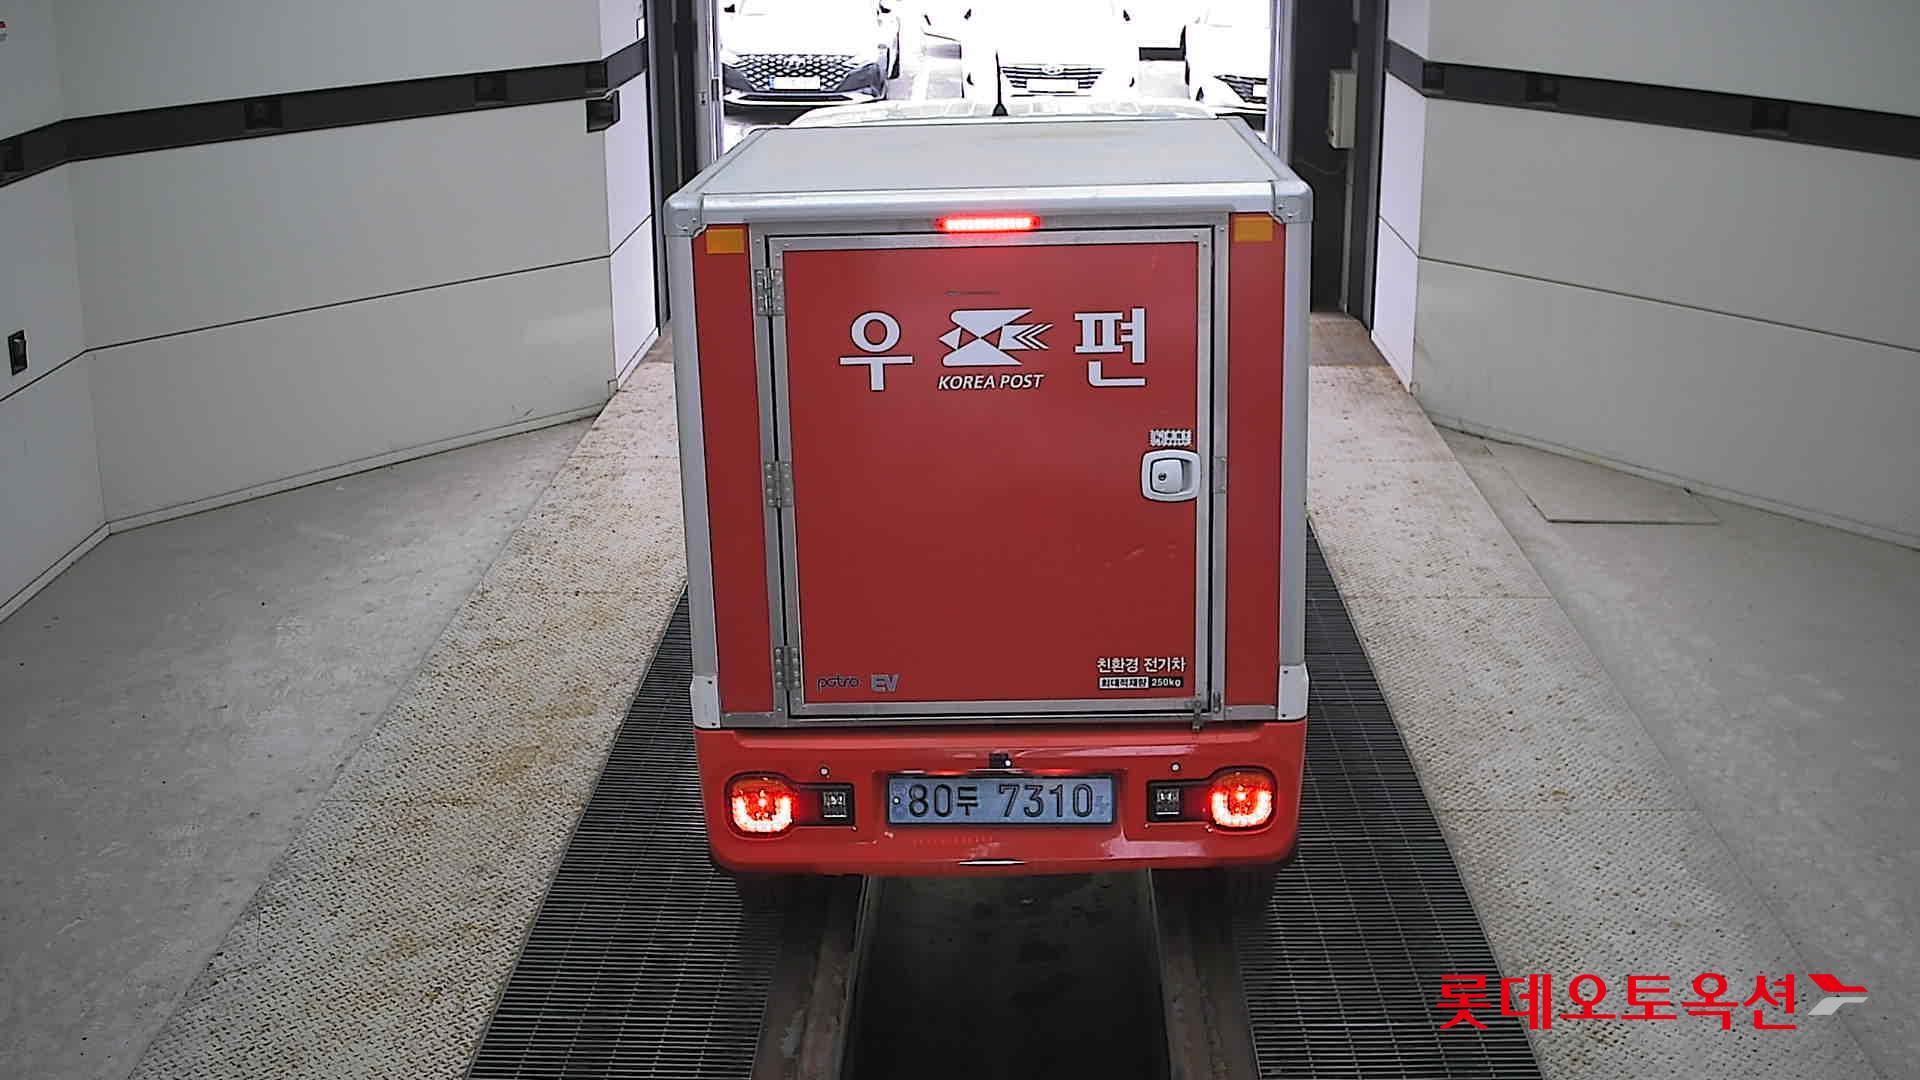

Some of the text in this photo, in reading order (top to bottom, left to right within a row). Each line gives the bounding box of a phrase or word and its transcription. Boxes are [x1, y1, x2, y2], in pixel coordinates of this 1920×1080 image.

[839, 307, 1147, 391] 우 편
[937, 374, 1045, 390] KOREA POST
[1097, 656, 1186, 673] 친환경 전기차
[871, 673, 899, 693] EV
[1151, 678, 1182, 688] 250kg
[908, 783, 979, 818] 80두
[999, 783, 1093, 818] 7310
